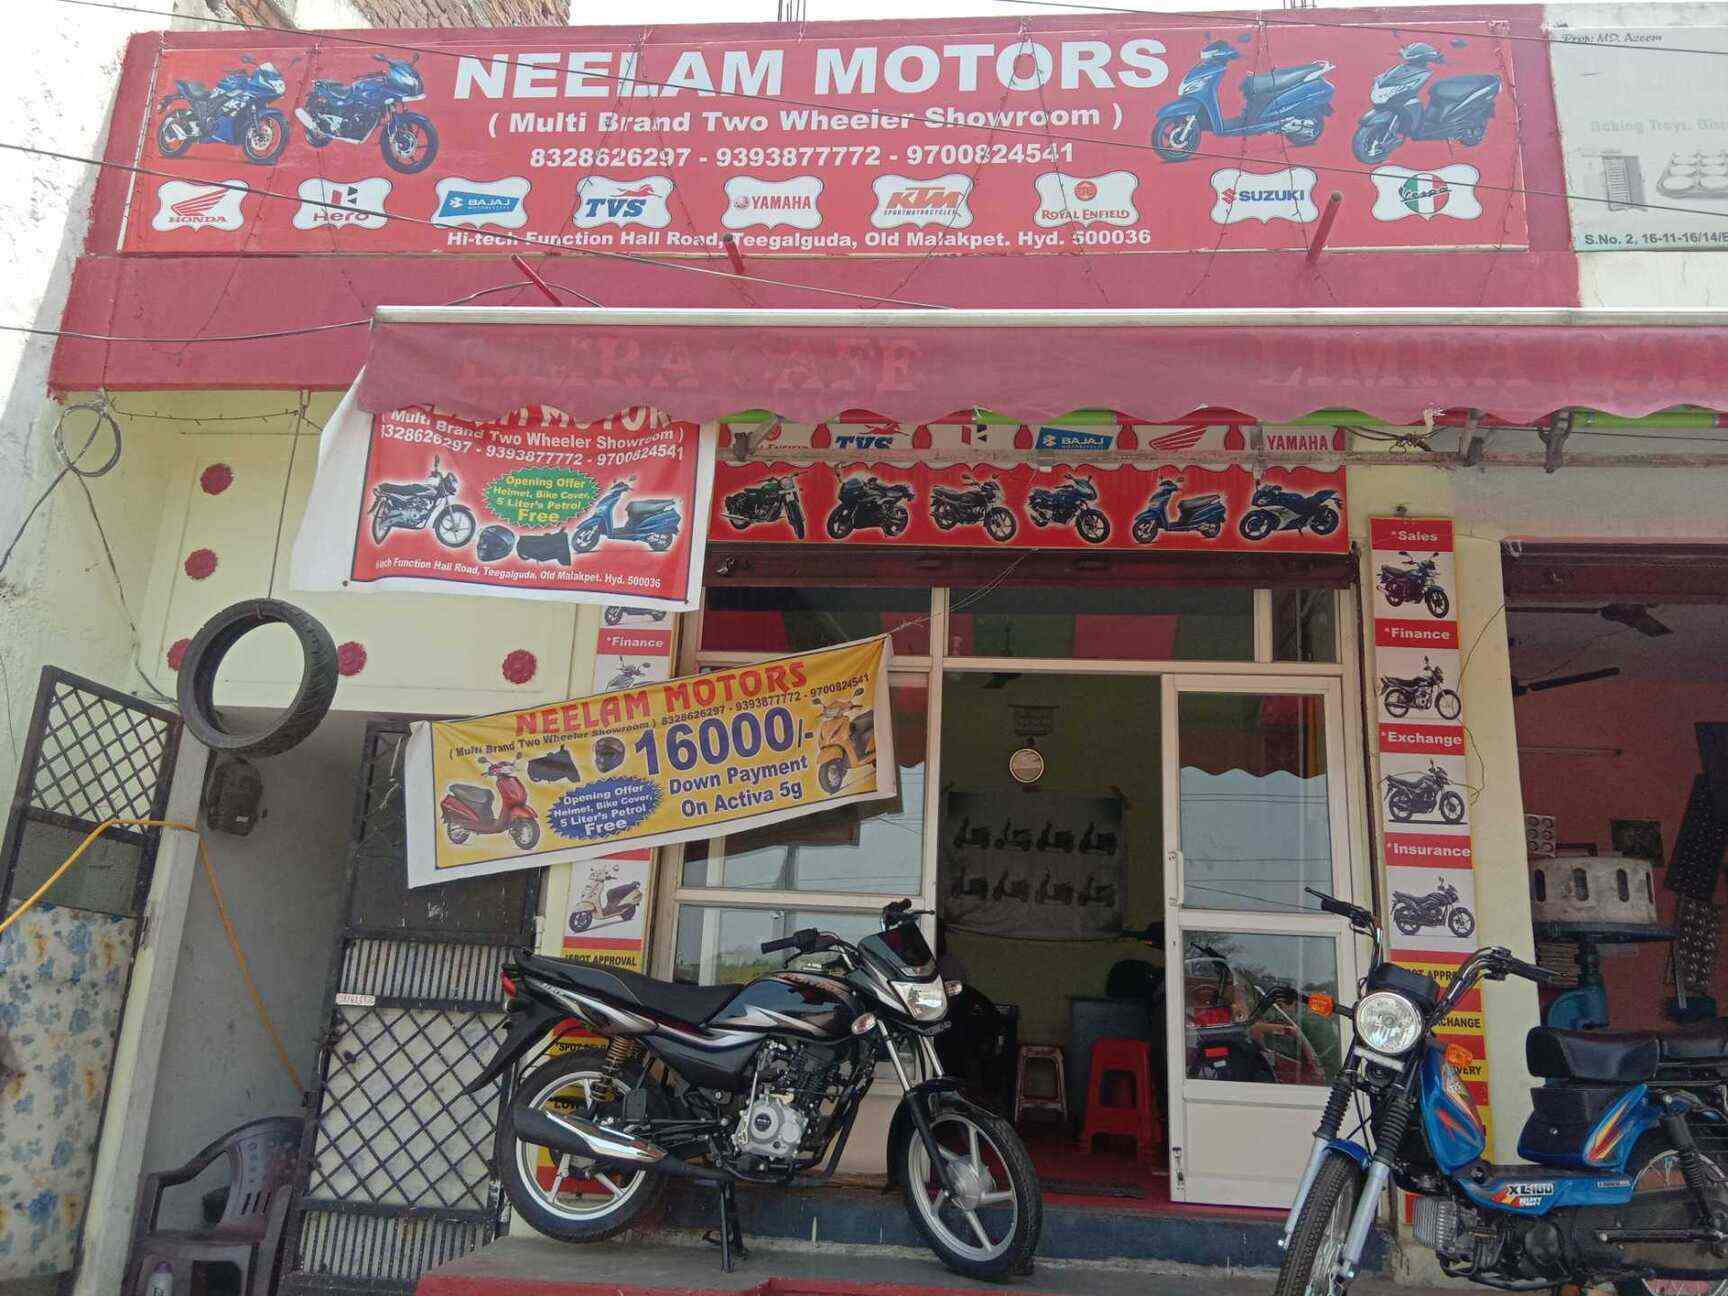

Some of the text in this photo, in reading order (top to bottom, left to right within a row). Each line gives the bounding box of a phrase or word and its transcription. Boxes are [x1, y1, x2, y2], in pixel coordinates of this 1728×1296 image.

[454, 39, 1169, 99] NEELAM MOTORS
[509, 112, 587, 132] Multi
[598, 112, 691, 132] Brand
[703, 111, 768, 132] Two
[925, 106, 1099, 129] Showroom
[530, 147, 692, 168] 8328626297
[716, 146, 881, 167] 9393877772
[906, 142, 1073, 165] 9700824541
[468, 198, 510, 207] BAJAJ
[751, 194, 812, 210] YAMAHA
[886, 187, 961, 209] KTM
[1238, 188, 1305, 202] SUZUKI
[313, 210, 370, 222] Hero
[584, 198, 648, 218] TVS
[1042, 208, 1129, 220] ROYAL ENFIELD
[168, 215, 228, 223] HONDA
[526, 231, 614, 247] Function
[620, 231, 660, 246] Hall
[864, 230, 899, 247] Old
[1018, 230, 1064, 249] Hyd.
[1072, 229, 1152, 246] 500036
[489, 430, 522, 446] Two
[526, 431, 592, 449] Wheeler
[835, 435, 894, 450] TVS
[1061, 437, 1104, 445] BAJAJ
[1266, 435, 1328, 450] YAMAHA
[505, 475, 585, 489] Opening Offer
[518, 508, 560, 522] Free
[515, 661, 807, 737] NEELAM MOTORS
[519, 737, 541, 749] Two
[543, 731, 588, 745] Wheeler
[635, 706, 814, 776] 16000/-
[669, 755, 808, 795] Down Payment
[563, 784, 644, 806] Opening Offer
[681, 781, 803, 818] On Activa 5g
[596, 800, 618, 810] Bike
[560, 818, 568, 828] 5
[611, 803, 646, 817] Petrol
[584, 818, 628, 836] Free
[592, 955, 638, 967] APPROVAL
[1438, 1016, 1481, 1028] CHANGE
